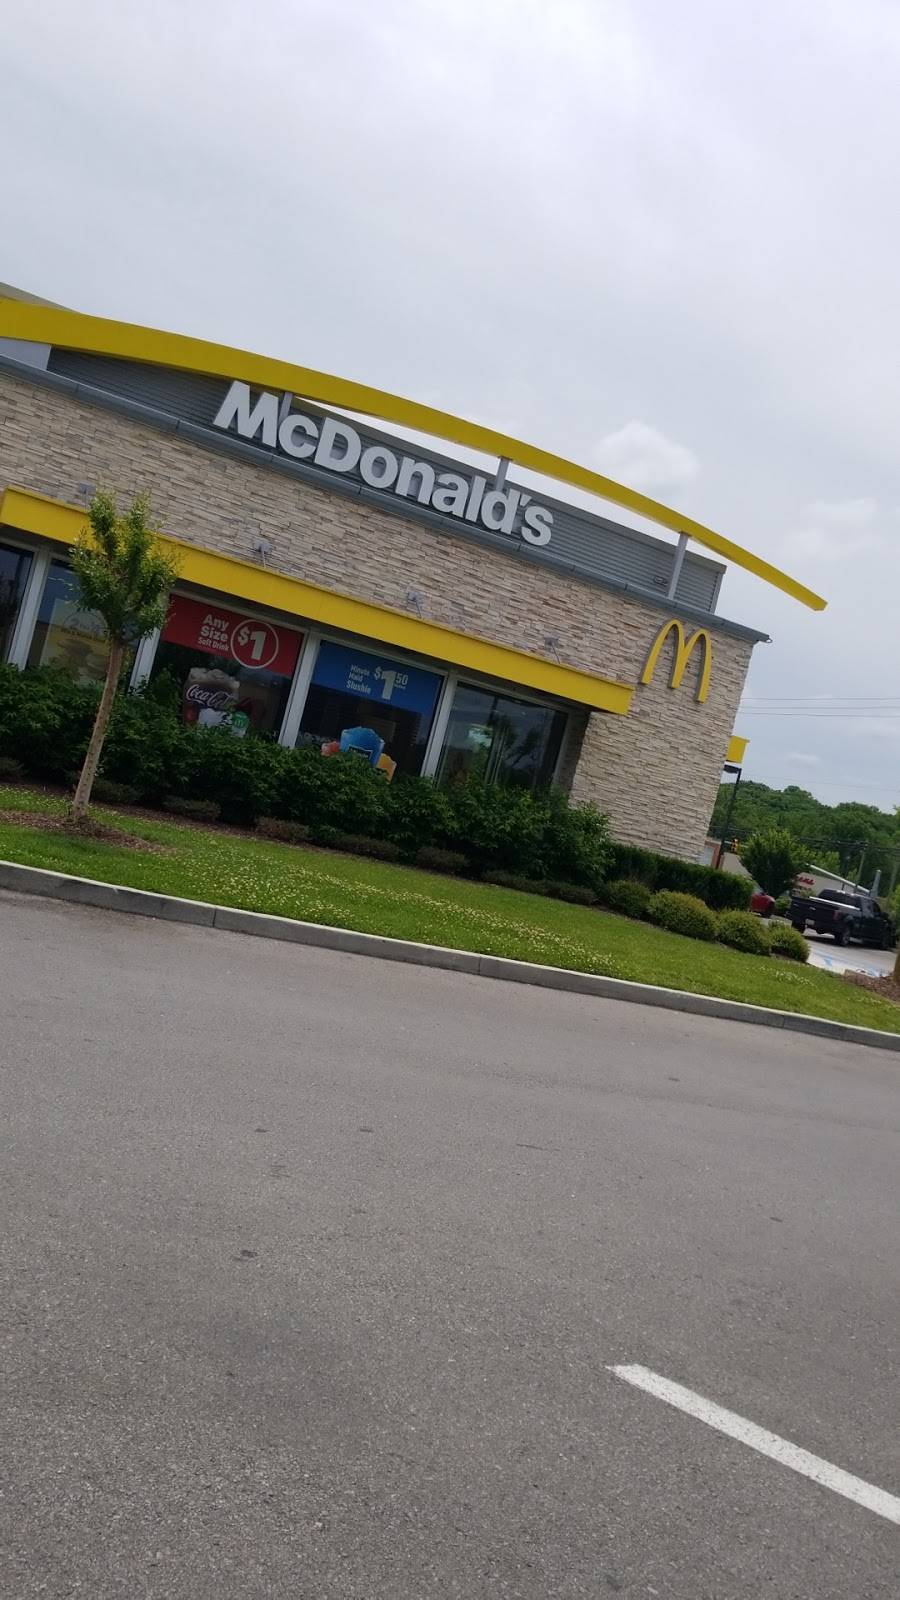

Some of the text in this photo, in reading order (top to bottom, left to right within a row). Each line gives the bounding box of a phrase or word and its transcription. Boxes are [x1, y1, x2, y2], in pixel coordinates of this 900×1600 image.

[213, 380, 554, 546] McDonald's
[203, 614, 229, 631] Any
[200, 625, 228, 642] Size
[198, 636, 230, 652] Soft Drink
[238, 626, 267, 660] $1
